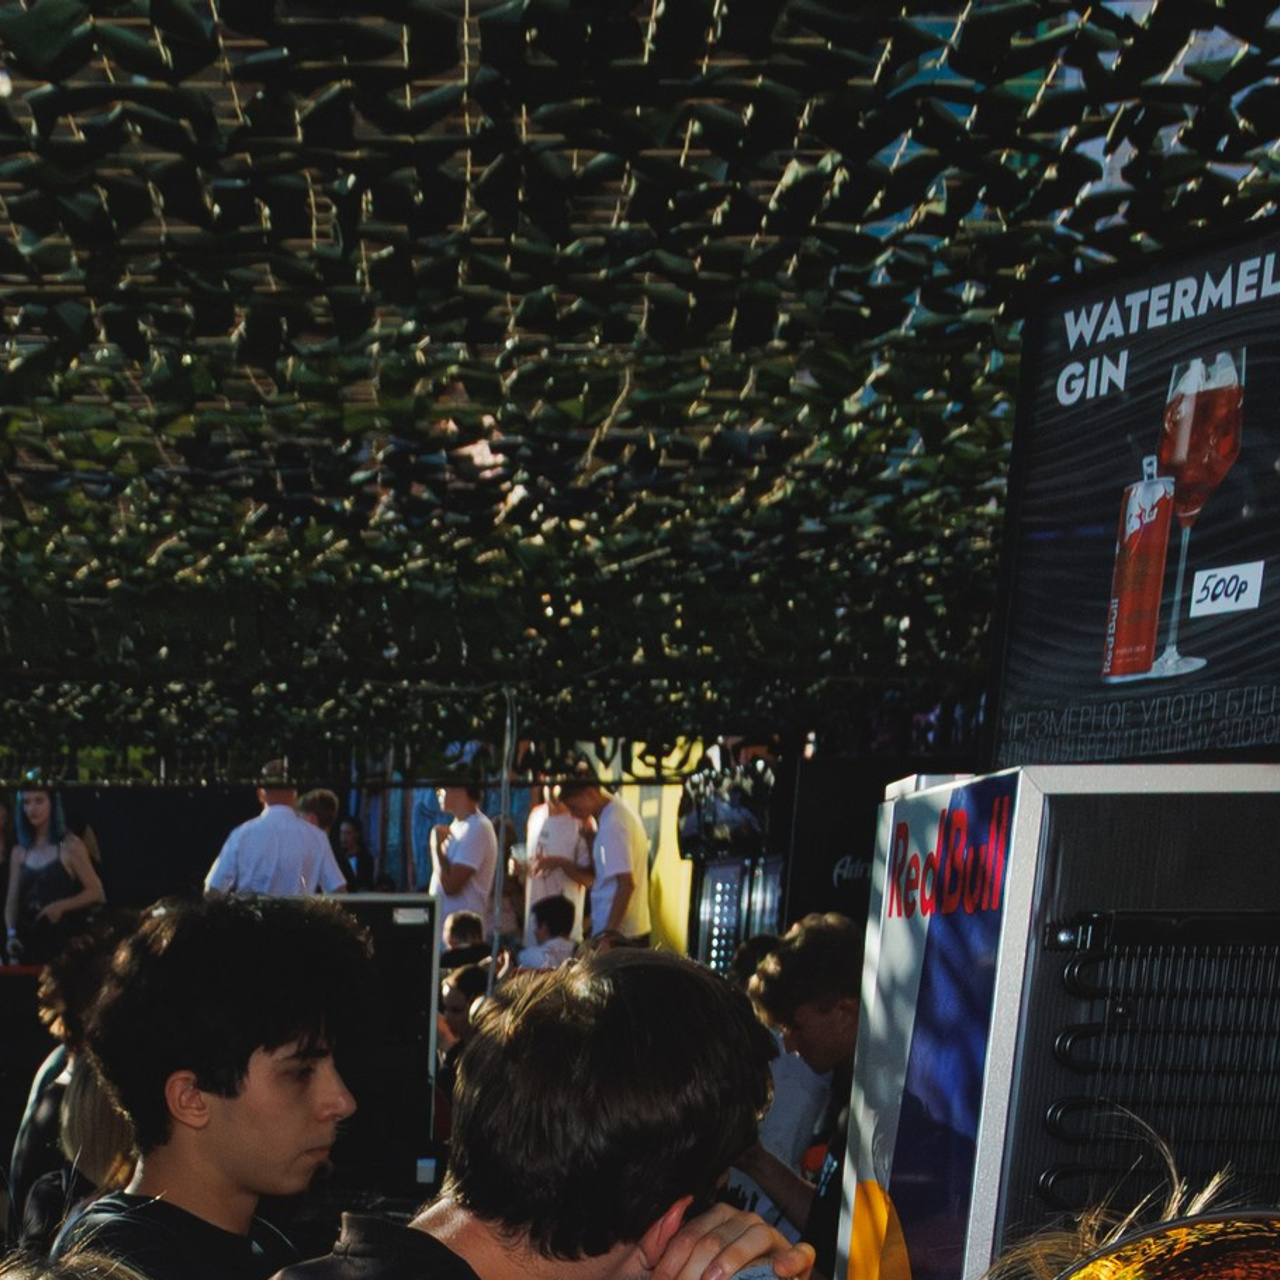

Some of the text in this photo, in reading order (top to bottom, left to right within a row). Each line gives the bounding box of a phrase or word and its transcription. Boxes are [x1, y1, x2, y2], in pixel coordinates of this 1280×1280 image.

[1064, 253, 1280, 350] WATERMEL
[1056, 349, 1129, 407] GIN
[888, 795, 1010, 919] Red Bull
